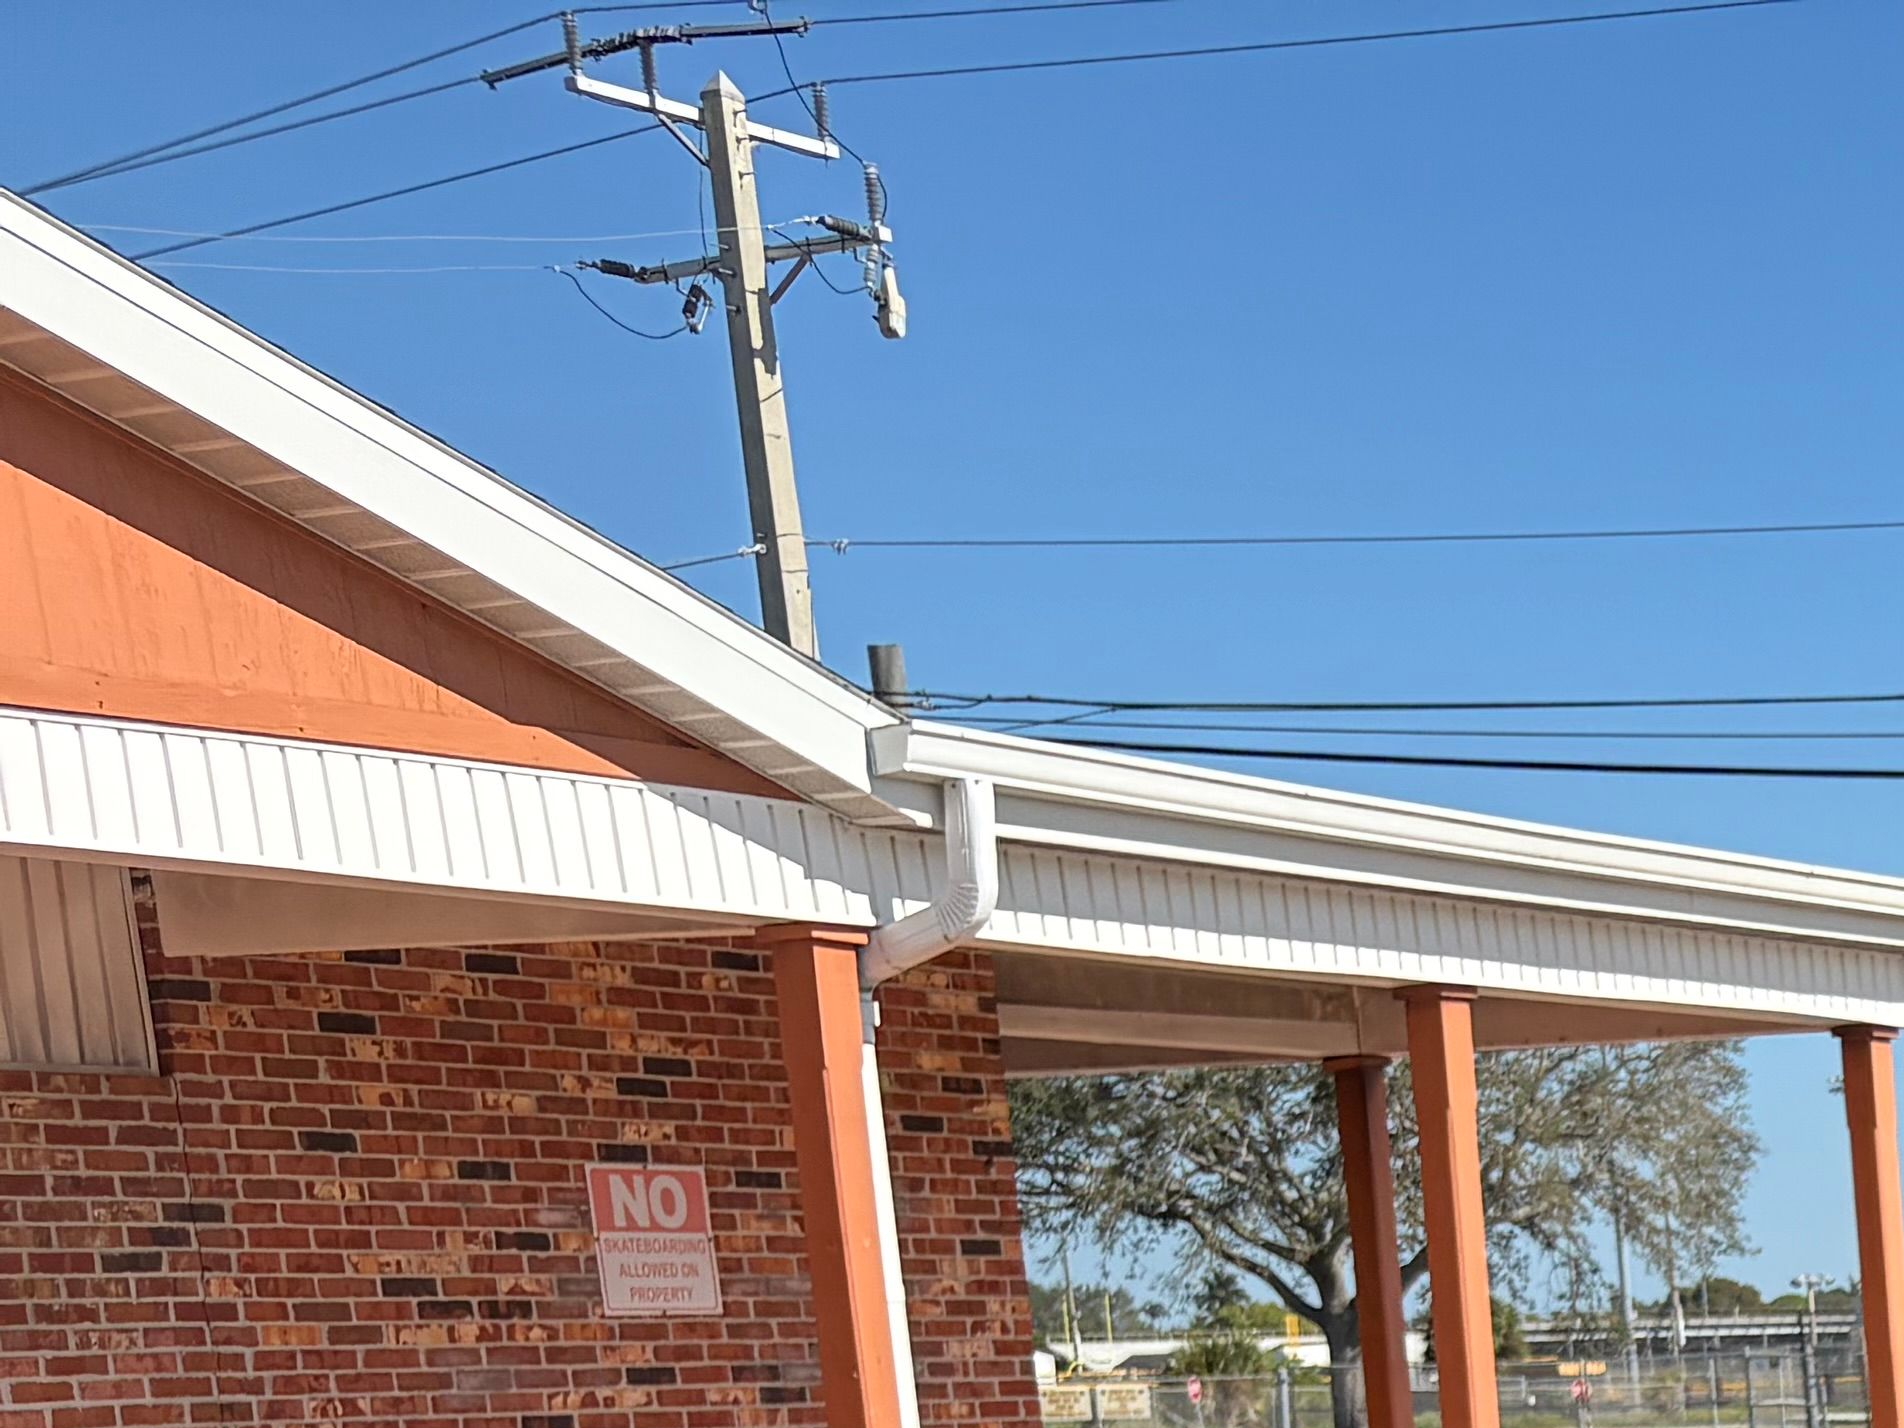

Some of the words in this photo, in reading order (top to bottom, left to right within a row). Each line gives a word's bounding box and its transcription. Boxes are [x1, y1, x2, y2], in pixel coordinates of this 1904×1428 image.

[608, 1173, 688, 1230] NO
[603, 1237, 706, 1254] SKATEBOARDING
[620, 1263, 678, 1278] ALLOWED
[681, 1262, 699, 1278] ON
[629, 1286, 693, 1303] PROPERTY
